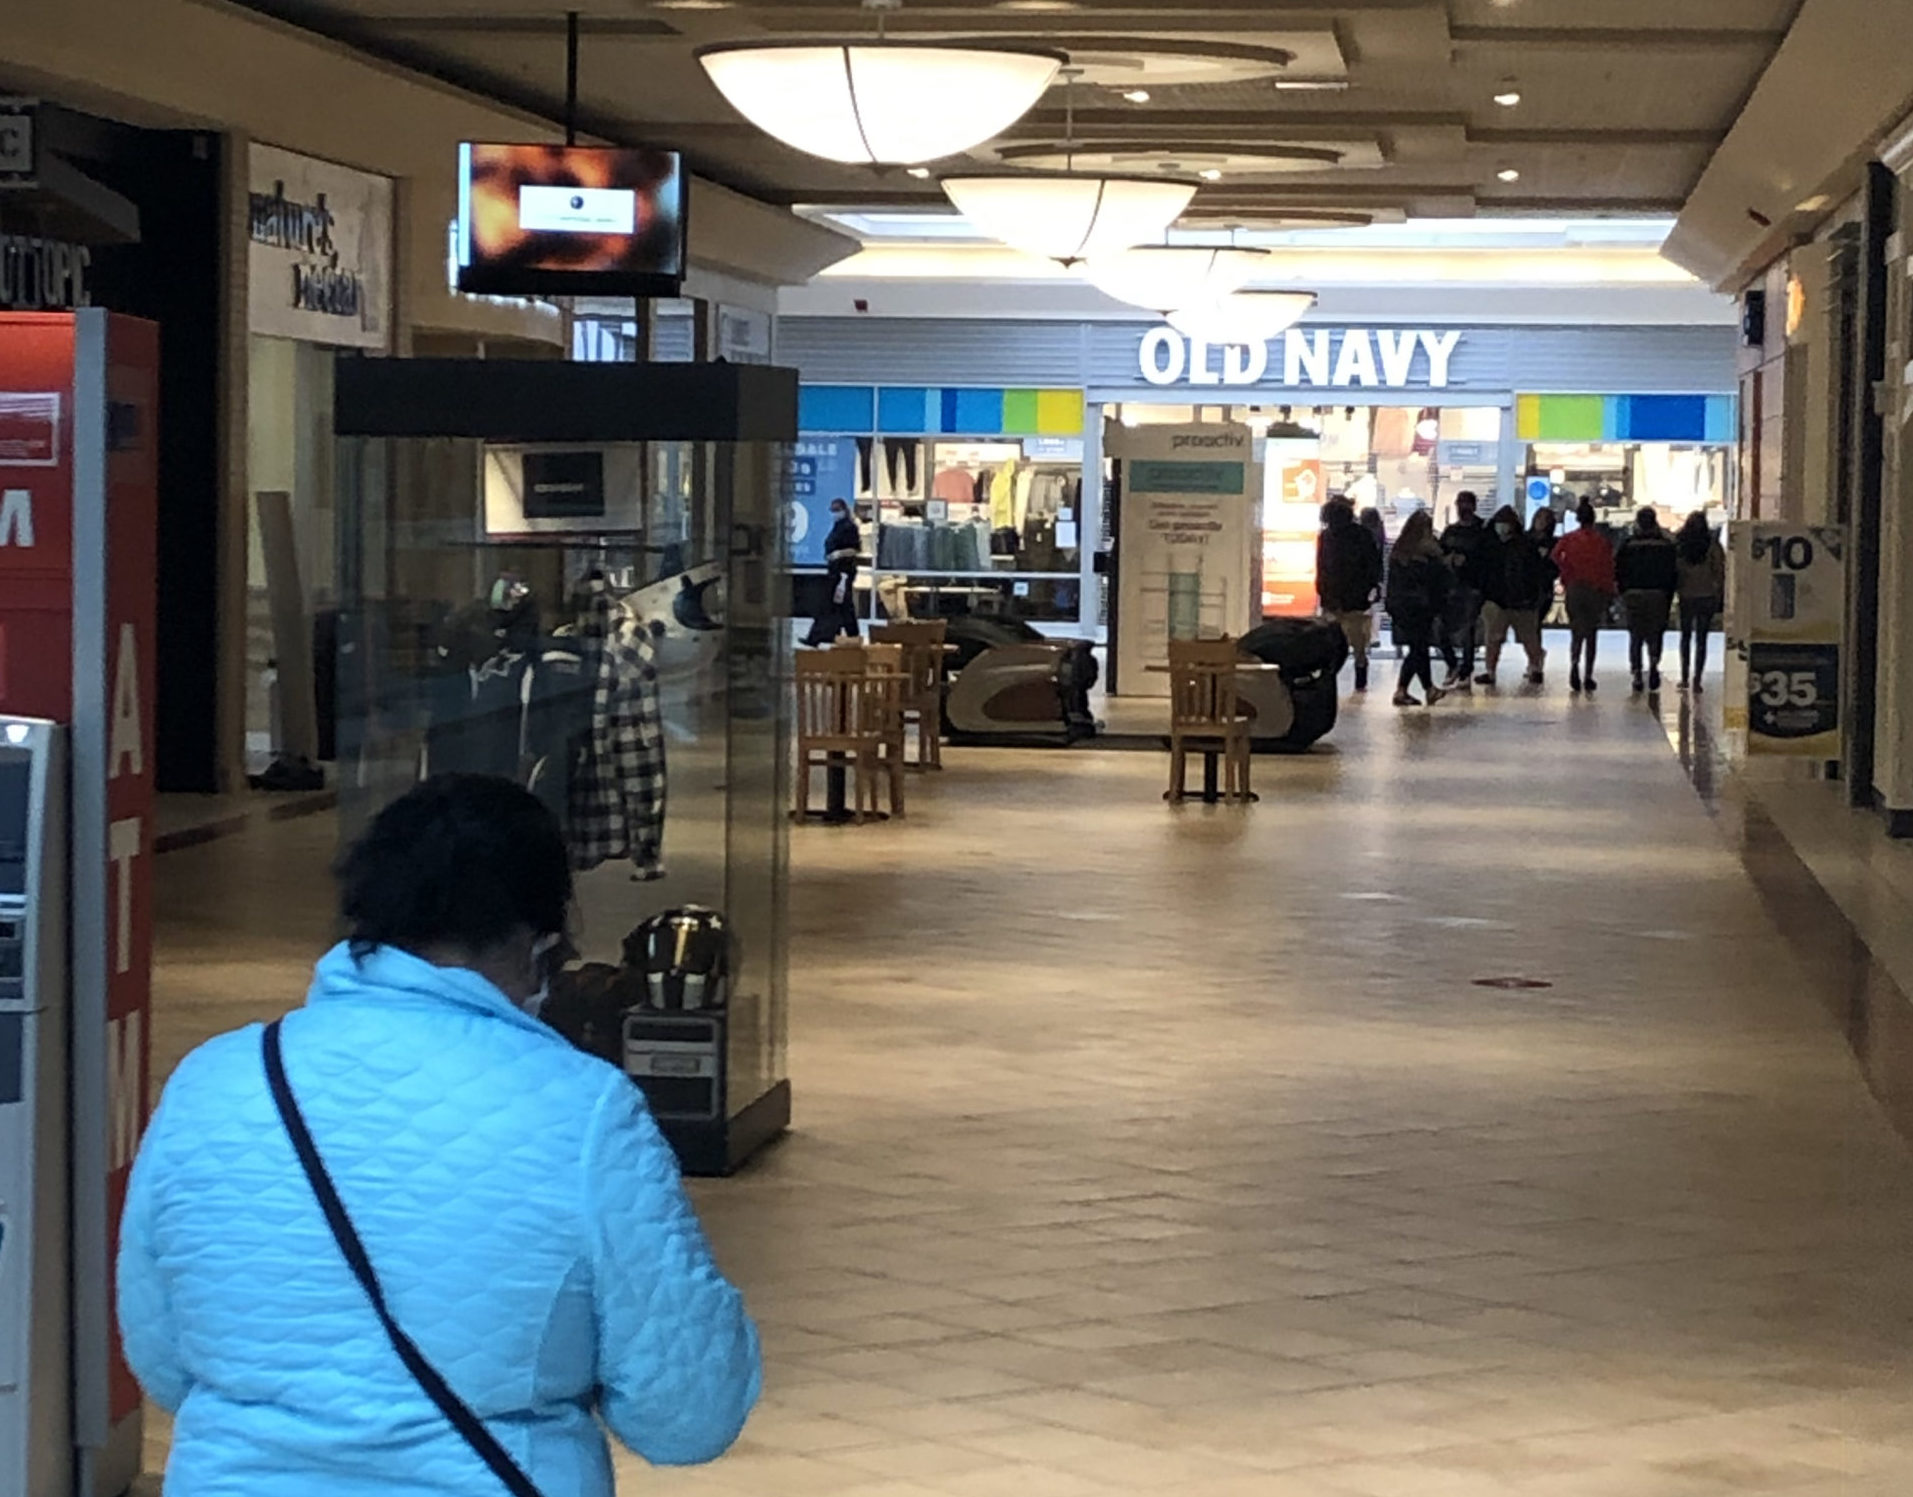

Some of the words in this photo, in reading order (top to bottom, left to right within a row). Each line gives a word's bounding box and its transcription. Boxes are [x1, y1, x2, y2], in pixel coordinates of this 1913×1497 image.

[1138, 327, 1268, 385] OLD
[1284, 328, 1462, 387] NAVY
[1171, 432, 1244, 450] proactiv
[107, 622, 144, 1170] ATM
